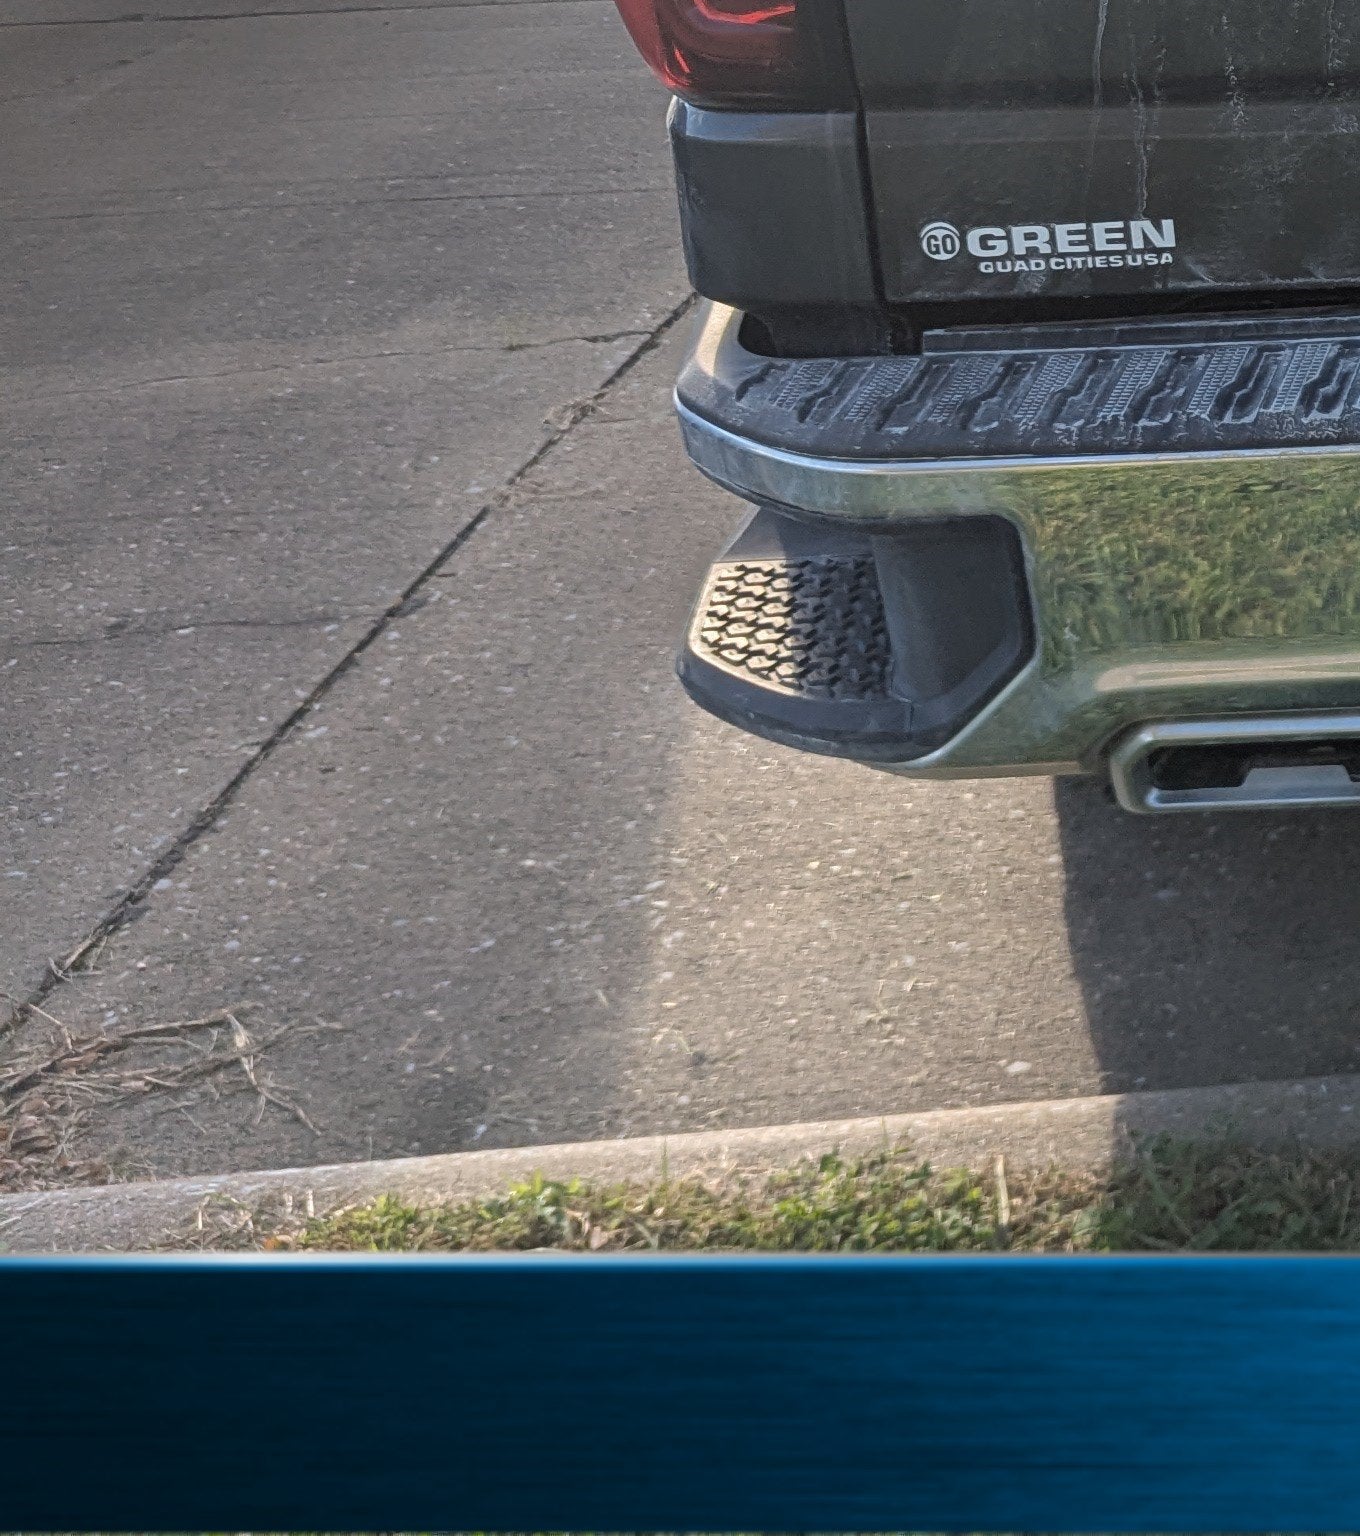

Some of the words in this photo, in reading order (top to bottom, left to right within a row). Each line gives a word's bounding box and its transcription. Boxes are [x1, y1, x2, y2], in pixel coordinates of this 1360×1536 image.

[966, 219, 1176, 258] GREEN
[978, 259, 1046, 274] QUAD
[1050, 254, 1123, 271] CITIES
[1126, 252, 1173, 267] USA
